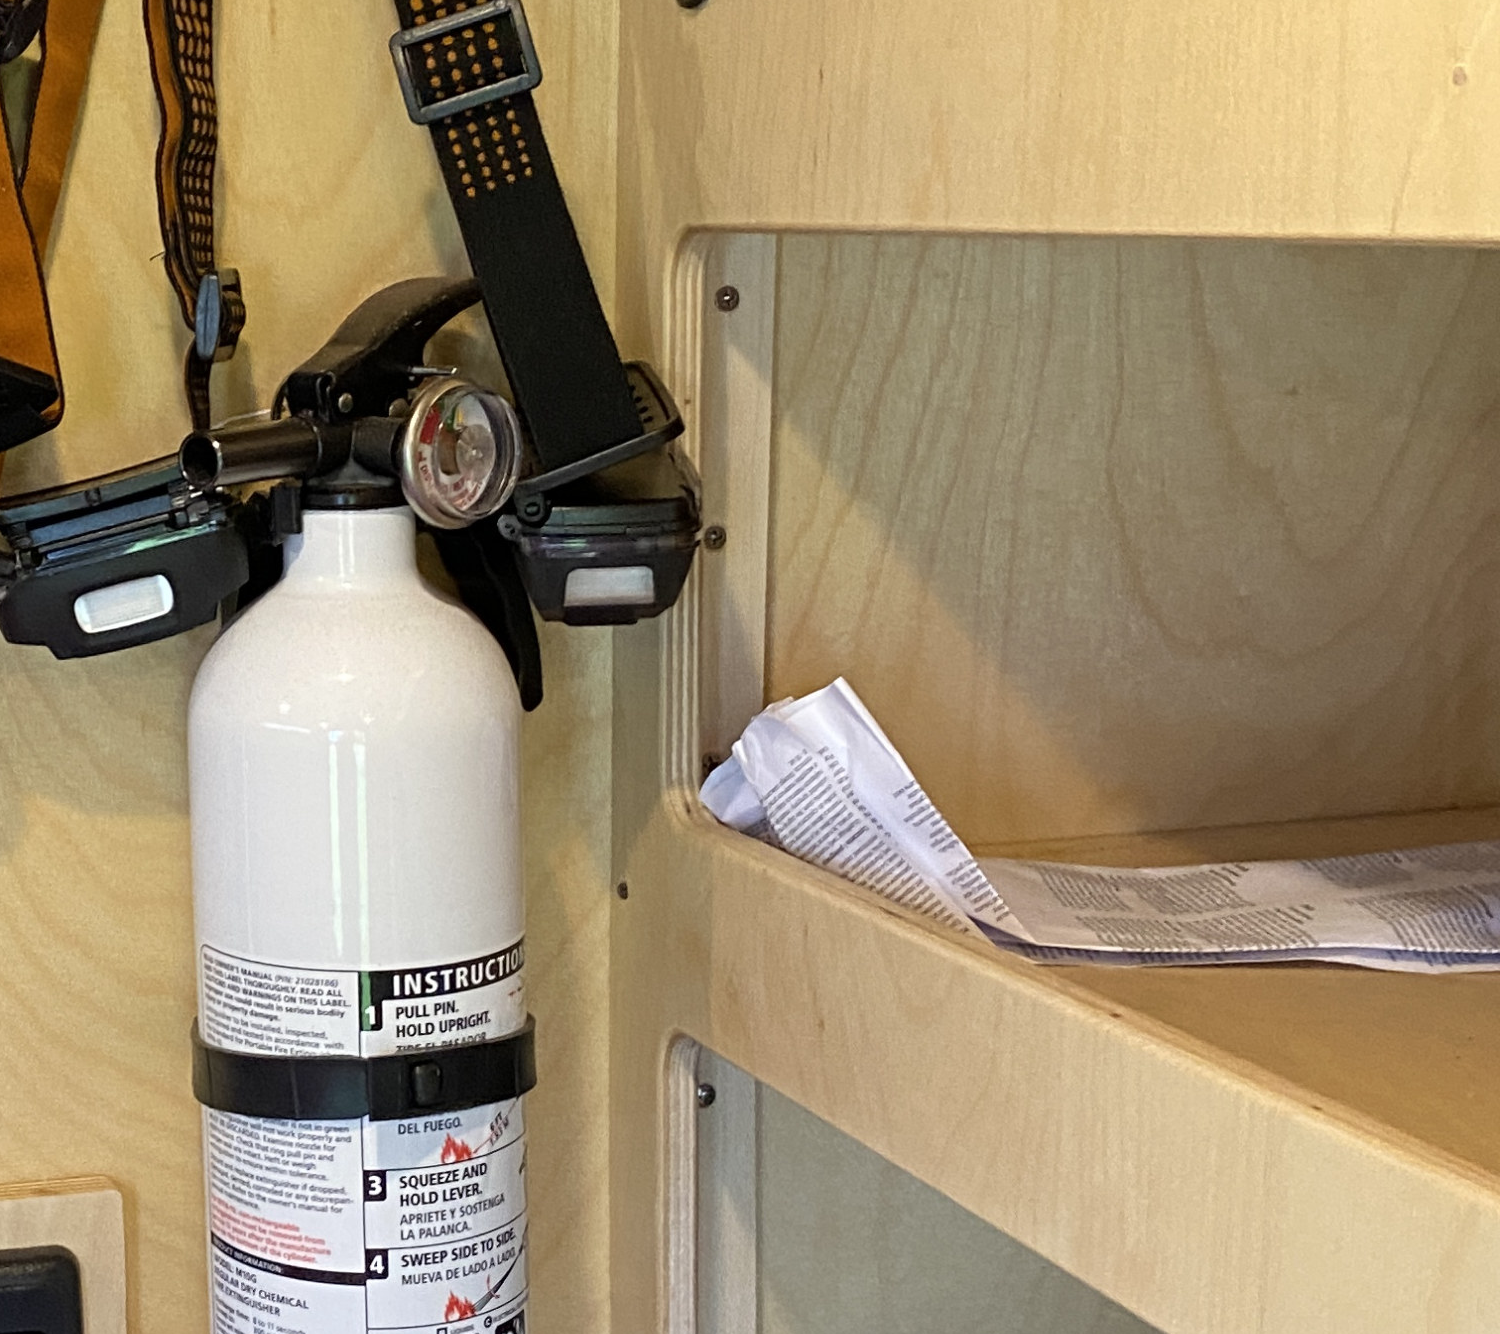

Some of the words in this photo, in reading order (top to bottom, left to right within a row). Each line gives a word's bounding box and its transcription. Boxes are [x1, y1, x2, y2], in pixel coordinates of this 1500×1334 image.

[240, 967, 272, 981] MANUAL
[241, 987, 281, 1002] WARNINGS
[283, 994, 296, 1004] ON
[298, 996, 317, 1005] THIS
[320, 997, 351, 1007] LABEL.
[299, 986, 323, 996] READ
[326, 988, 343, 997] ALL
[284, 1005, 314, 1015] serious
[316, 1007, 345, 1018] bodily
[365, 1006, 376, 1025] 1
[396, 1004, 430, 1019] PULL
[434, 1000, 459, 1016] PIN.
[396, 1022, 435, 1038] HOLD
[439, 1010, 491, 1033] UPRIGHT.
[398, 1123, 420, 1135] DEL
[423, 1117, 462, 1132] FUEGO.
[400, 1169, 460, 1189] SQUEEZE
[462, 1162, 488, 1180] AND
[368, 1176, 382, 1196] 3
[400, 1191, 438, 1207] HOLD
[443, 1182, 483, 1198] LEVER.
[400, 1210, 447, 1226] APRIETE
[450, 1208, 456, 1219] Y
[460, 1192, 506, 1217] SOSTENGA
[400, 1229, 415, 1241] LA
[419, 1221, 472, 1239] PALANCA.
[401, 1250, 448, 1268] SWEEP
[451, 1242, 478, 1261] SIDE
[480, 1238, 494, 1253] TO
[369, 1255, 385, 1274] 4
[401, 1271, 443, 1286] MUEVA
[446, 1267, 460, 1280] DE
[462, 1260, 488, 1276] LADO
[489, 1257, 495, 1268] A
[240, 1281, 256, 1296] DRY
[258, 1288, 309, 1309] CHEMICAL
